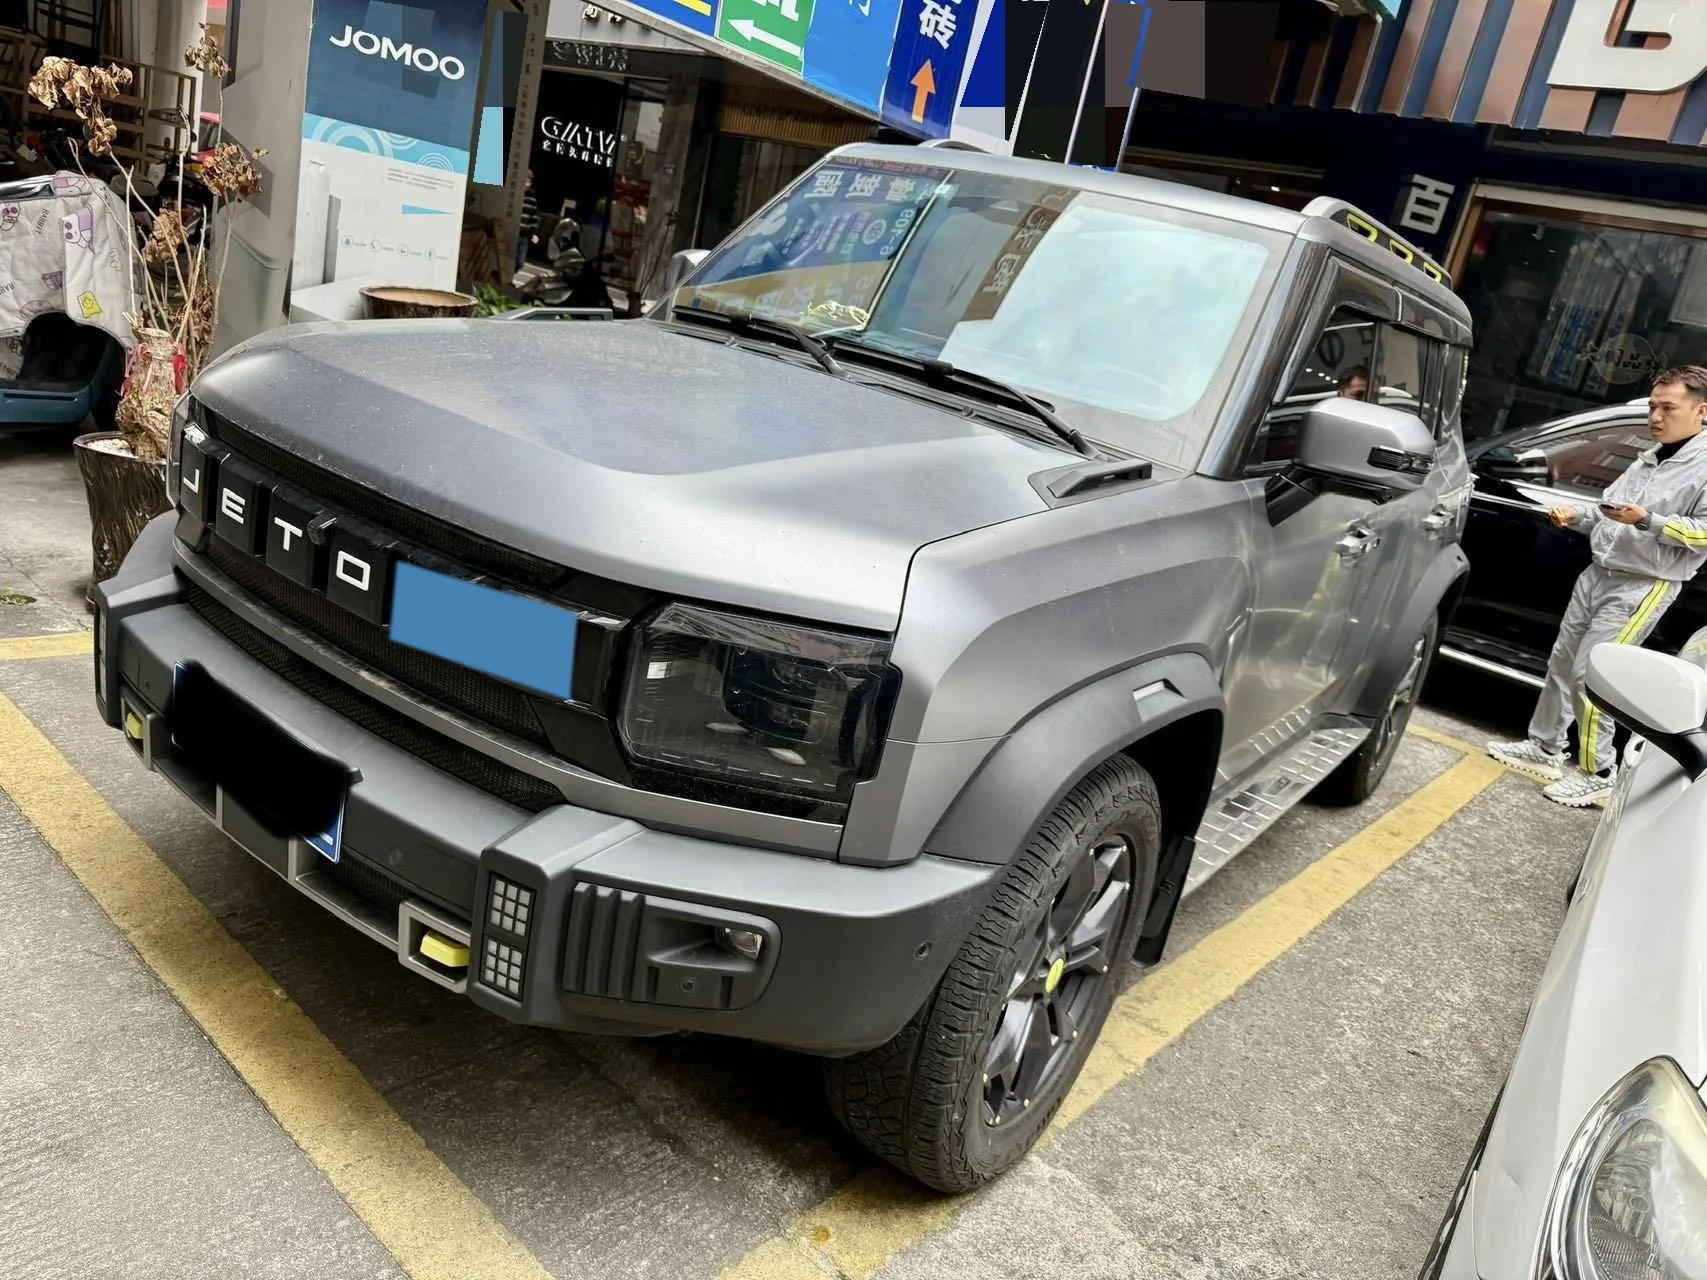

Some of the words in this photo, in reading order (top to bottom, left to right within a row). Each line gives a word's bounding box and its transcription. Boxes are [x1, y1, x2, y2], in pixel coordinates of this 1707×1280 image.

[918, 0, 962, 50] 砖
[329, 24, 465, 80] JOMOO
[34, 208, 50, 236] RABBIT
[1400, 173, 1456, 256] 百
